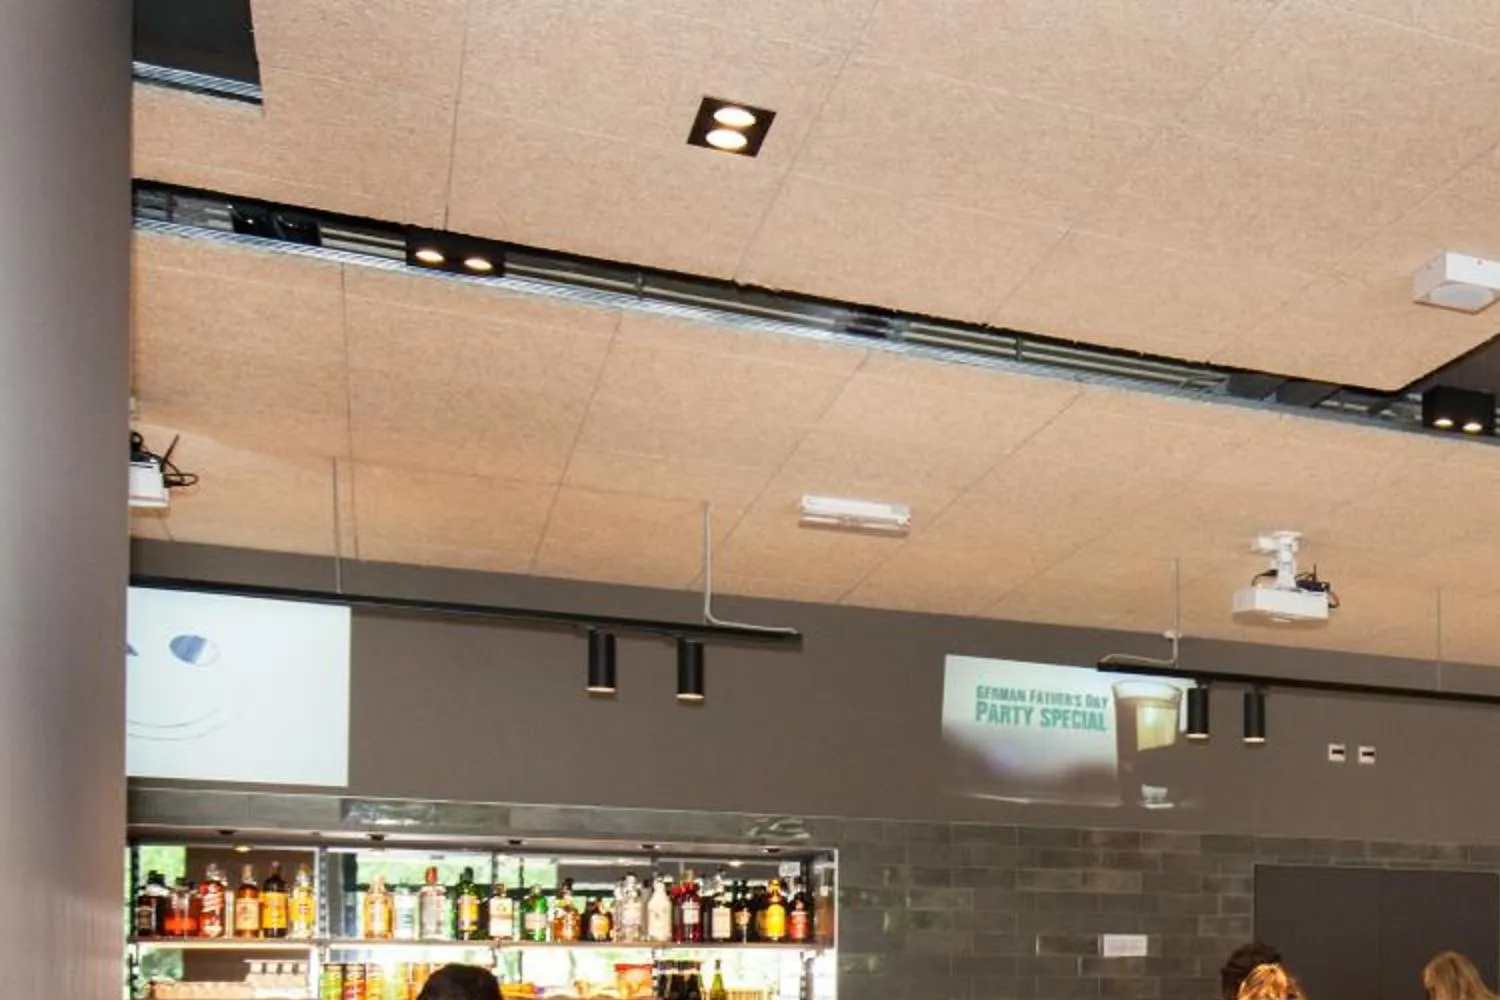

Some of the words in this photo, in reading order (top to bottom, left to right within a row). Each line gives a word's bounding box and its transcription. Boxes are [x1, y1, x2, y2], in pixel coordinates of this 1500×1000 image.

[976, 685, 1026, 702] GERMAN
[1084, 693, 1108, 709] DAY
[976, 701, 1034, 726] PARTY
[1040, 708, 1107, 732] SPECIAL
